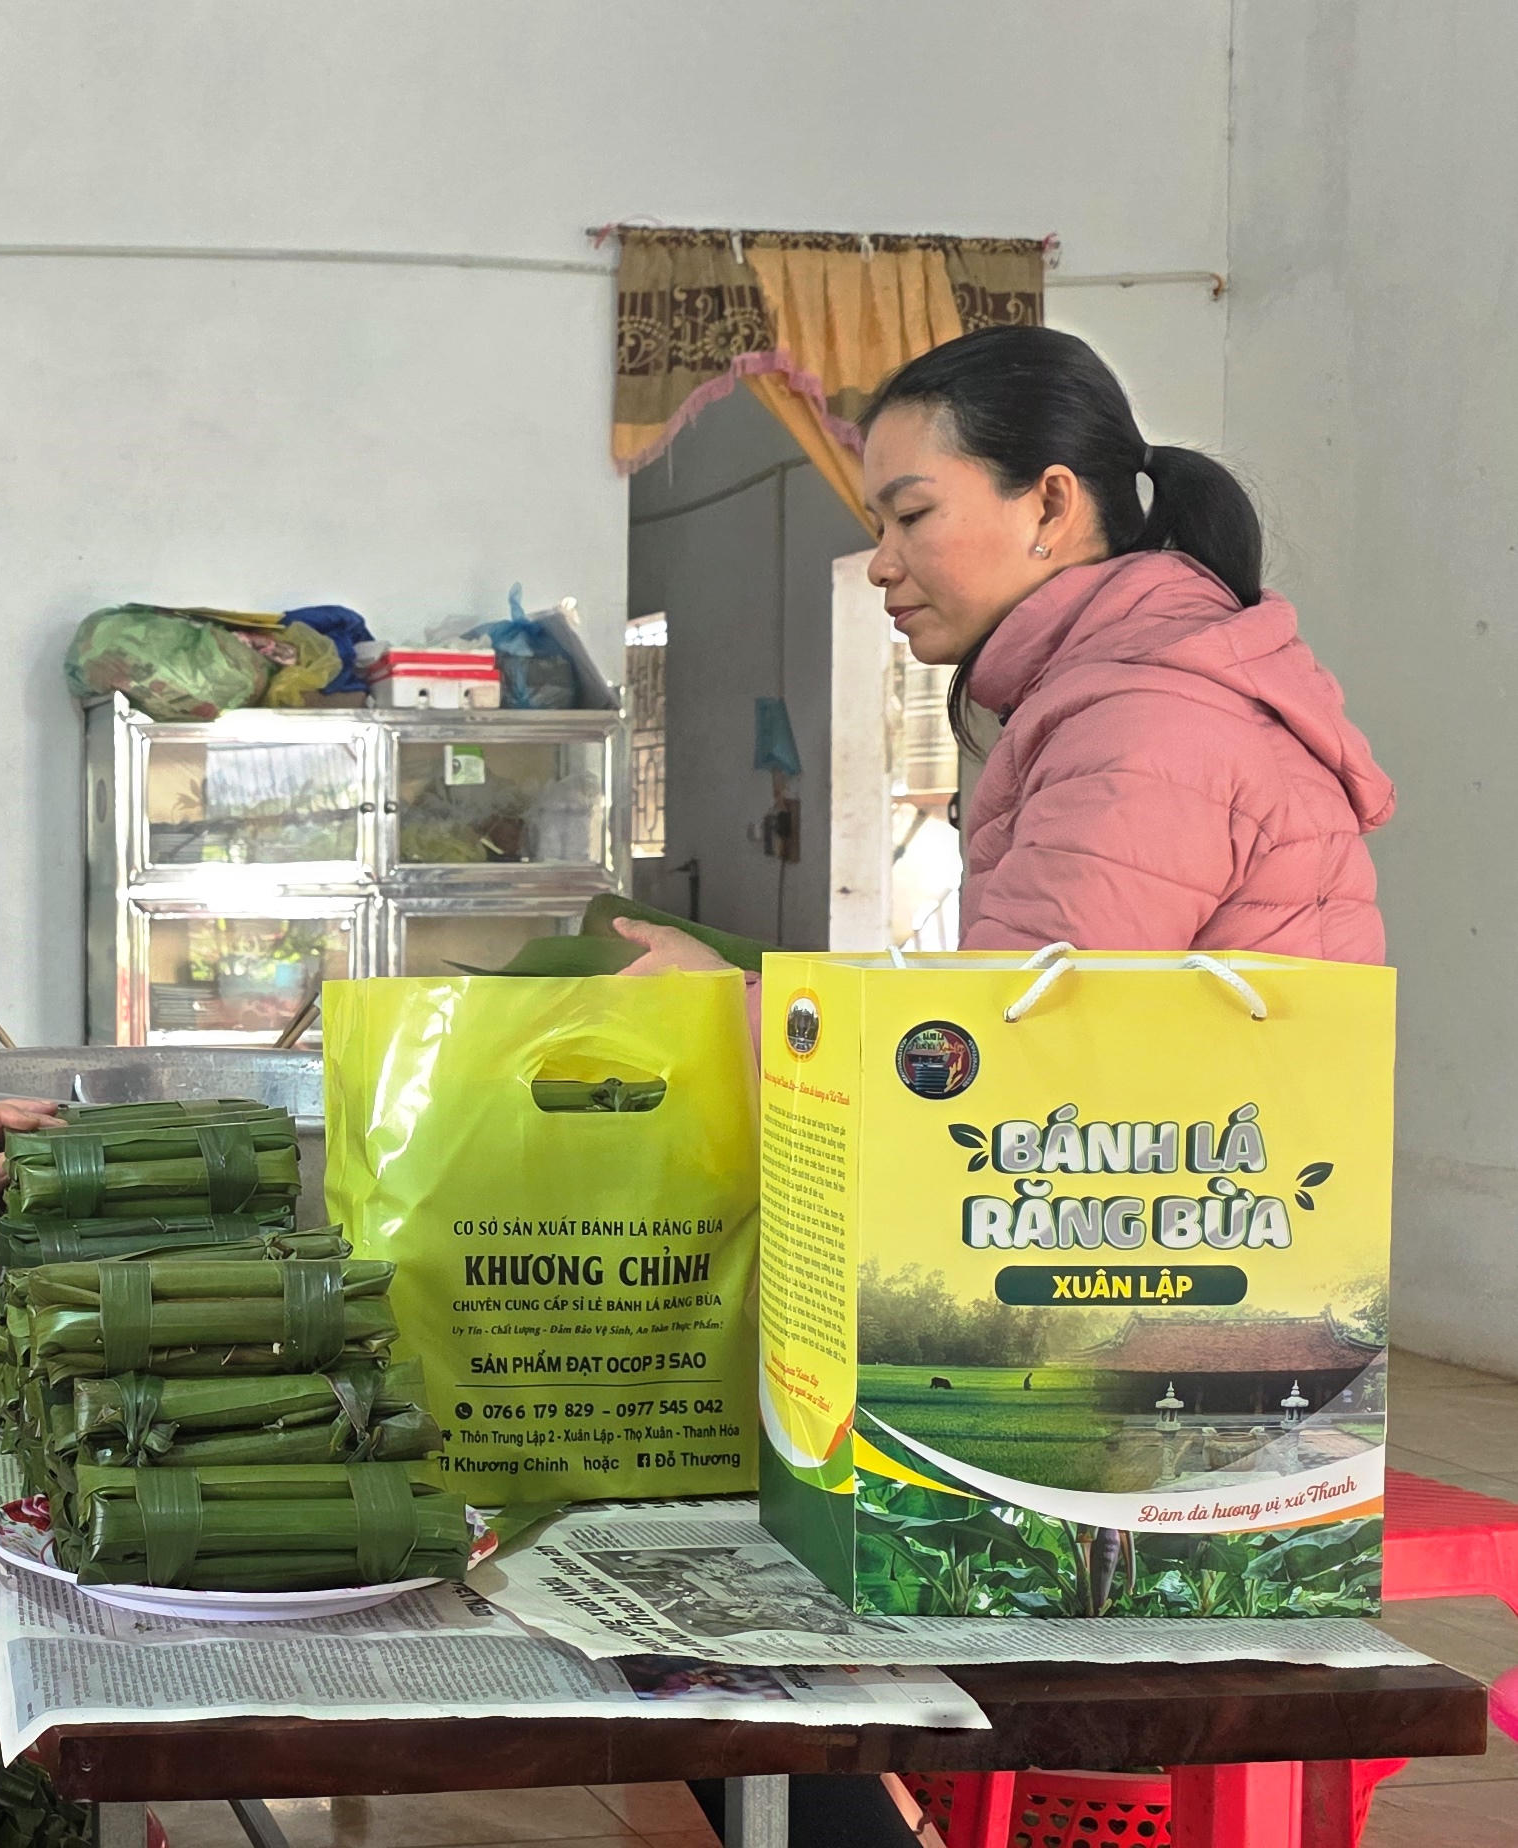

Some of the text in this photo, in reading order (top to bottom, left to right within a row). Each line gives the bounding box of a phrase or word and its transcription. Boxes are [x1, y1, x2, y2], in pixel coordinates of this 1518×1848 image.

[992, 1102, 1266, 1173] BÁNH LÁ
[479, 1216, 498, 1236] SỞ
[503, 1217, 532, 1236] SẢN
[537, 1215, 577, 1236] XUẤT
[581, 1216, 624, 1236] BÁNH
[630, 1217, 648, 1237] LÁ
[962, 1176, 1292, 1249] RĂNG BỪA
[465, 1246, 711, 1286] KHƯƠNG CHỈNH
[1052, 1268, 1193, 1304] XUÂN LẬP
[452, 1296, 501, 1312] CHUYÊN
[505, 1299, 539, 1311] CUNG
[544, 1295, 569, 1311] CẤP
[607, 1297, 642, 1312] BÁNH
[646, 1297, 660, 1312] LÁ
[471, 1349, 707, 1376] SẢN PHẨM ĐẠT OCOP 3 SAO
[483, 1404, 526, 1419] 0766
[533, 1403, 557, 1419] 179
[564, 1402, 594, 1418] 829
[616, 1401, 654, 1418] 0977
[659, 1400, 688, 1415] 545
[693, 1399, 723, 1414] 042
[460, 1429, 488, 1444] Thôn
[491, 1430, 523, 1447] Trung
[526, 1430, 546, 1446] Lập
[548, 1430, 555, 1443] 2
[563, 1428, 590, 1443] Xuân
[593, 1428, 614, 1444] Lập
[624, 1428, 642, 1443] Thọ
[645, 1426, 673, 1439] Xuân
[683, 1425, 716, 1439] Thanh
[454, 1456, 519, 1475] Khương
[583, 1456, 619, 1473] hoặc
[655, 1450, 676, 1468] Đỗ
[680, 1452, 740, 1468] Thương
[1187, 1503, 1209, 1520] đà
[1212, 1502, 1262, 1520] hương
[1265, 1500, 1281, 1514] vị
[1306, 1476, 1357, 1503] Thanh
